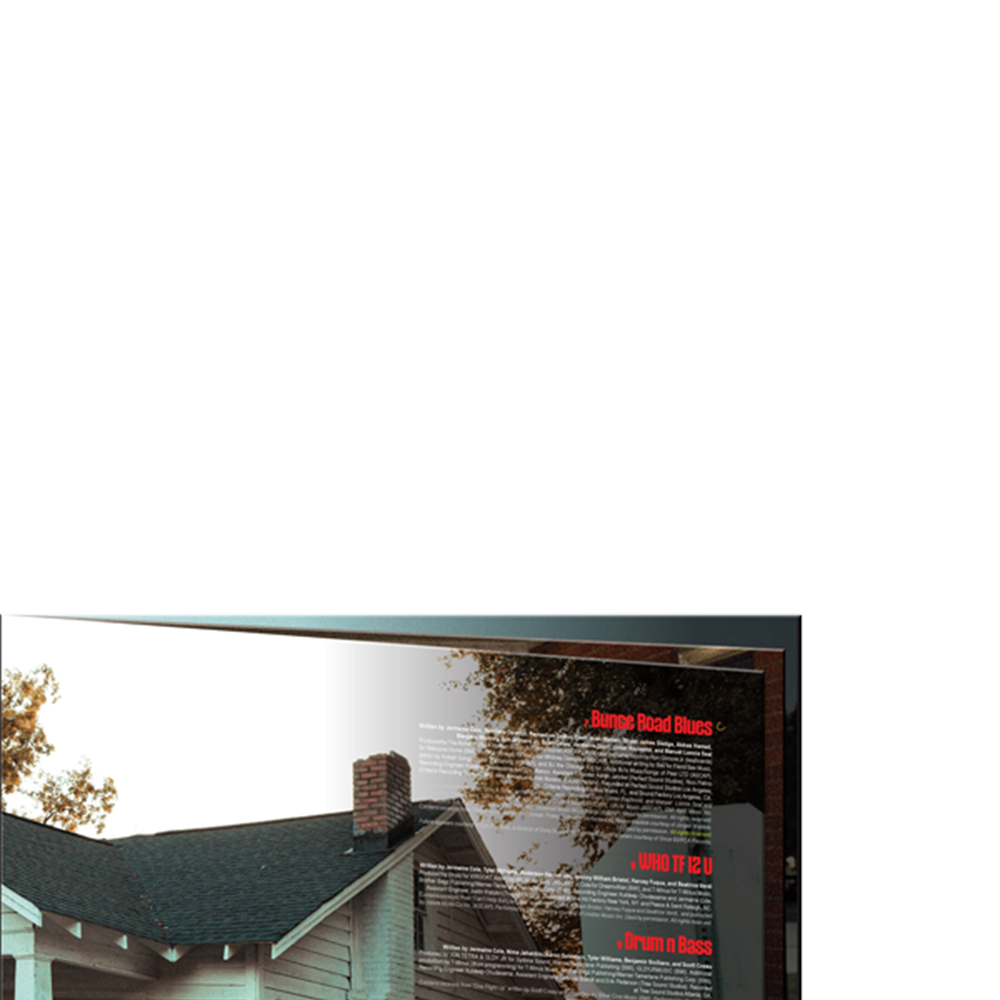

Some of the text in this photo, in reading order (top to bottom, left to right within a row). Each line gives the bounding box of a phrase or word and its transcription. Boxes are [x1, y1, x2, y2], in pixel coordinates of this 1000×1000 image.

[590, 708, 634, 730] Bunce
[636, 712, 672, 734] Road
[674, 716, 712, 736] Blues
[638, 852, 670, 872] WHO
[672, 854, 686, 874] TF
[704, 856, 712, 876] U
[624, 932, 664, 952] Drum
[666, 936, 676, 954] n
[678, 936, 712, 956] Bass
